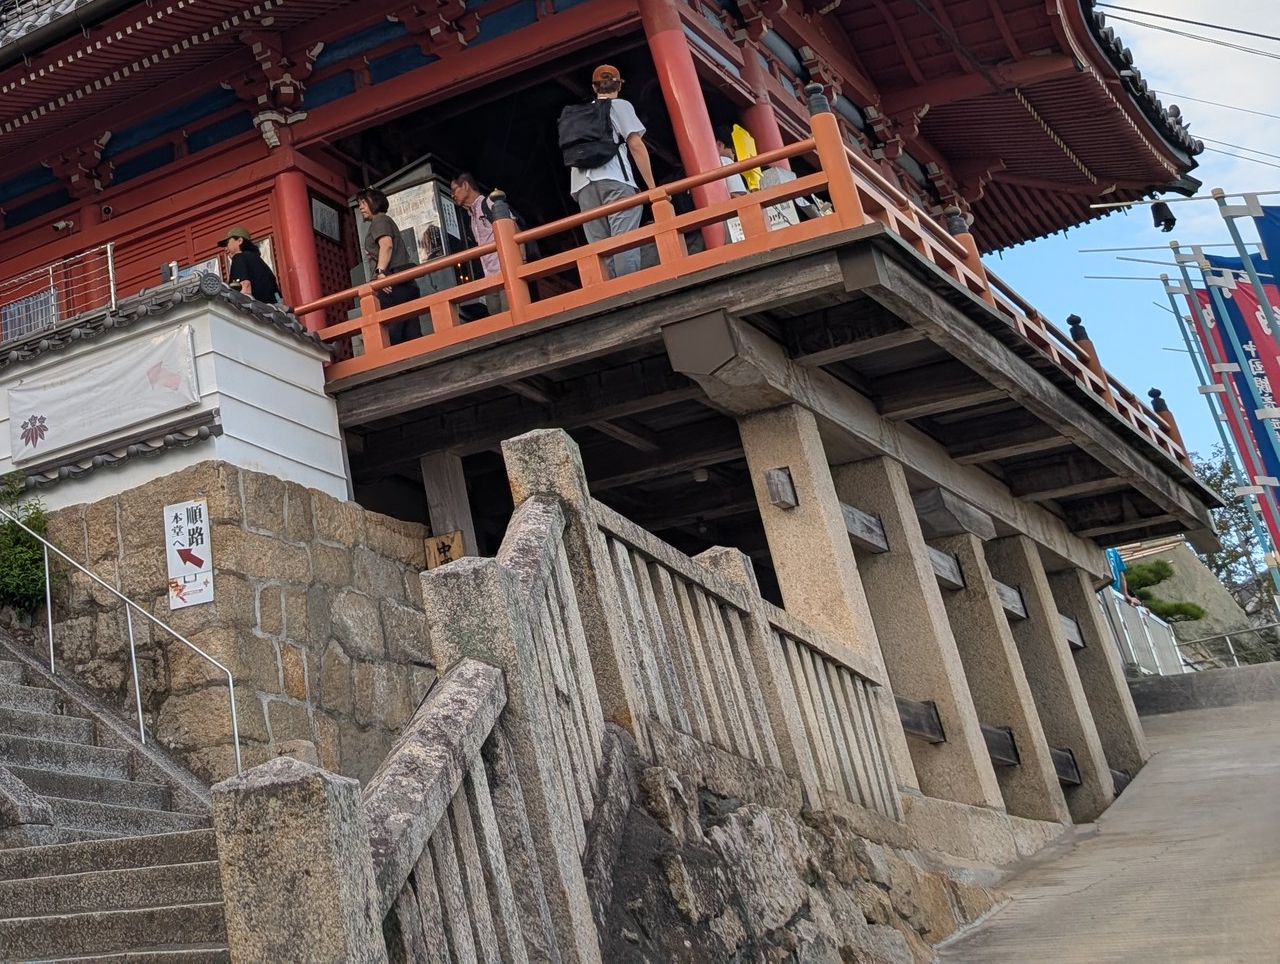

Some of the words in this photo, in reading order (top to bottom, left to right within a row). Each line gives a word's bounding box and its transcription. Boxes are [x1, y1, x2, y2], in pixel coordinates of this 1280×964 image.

[171, 512, 185, 547] 本堂へ
[185, 503, 204, 548] 順路
